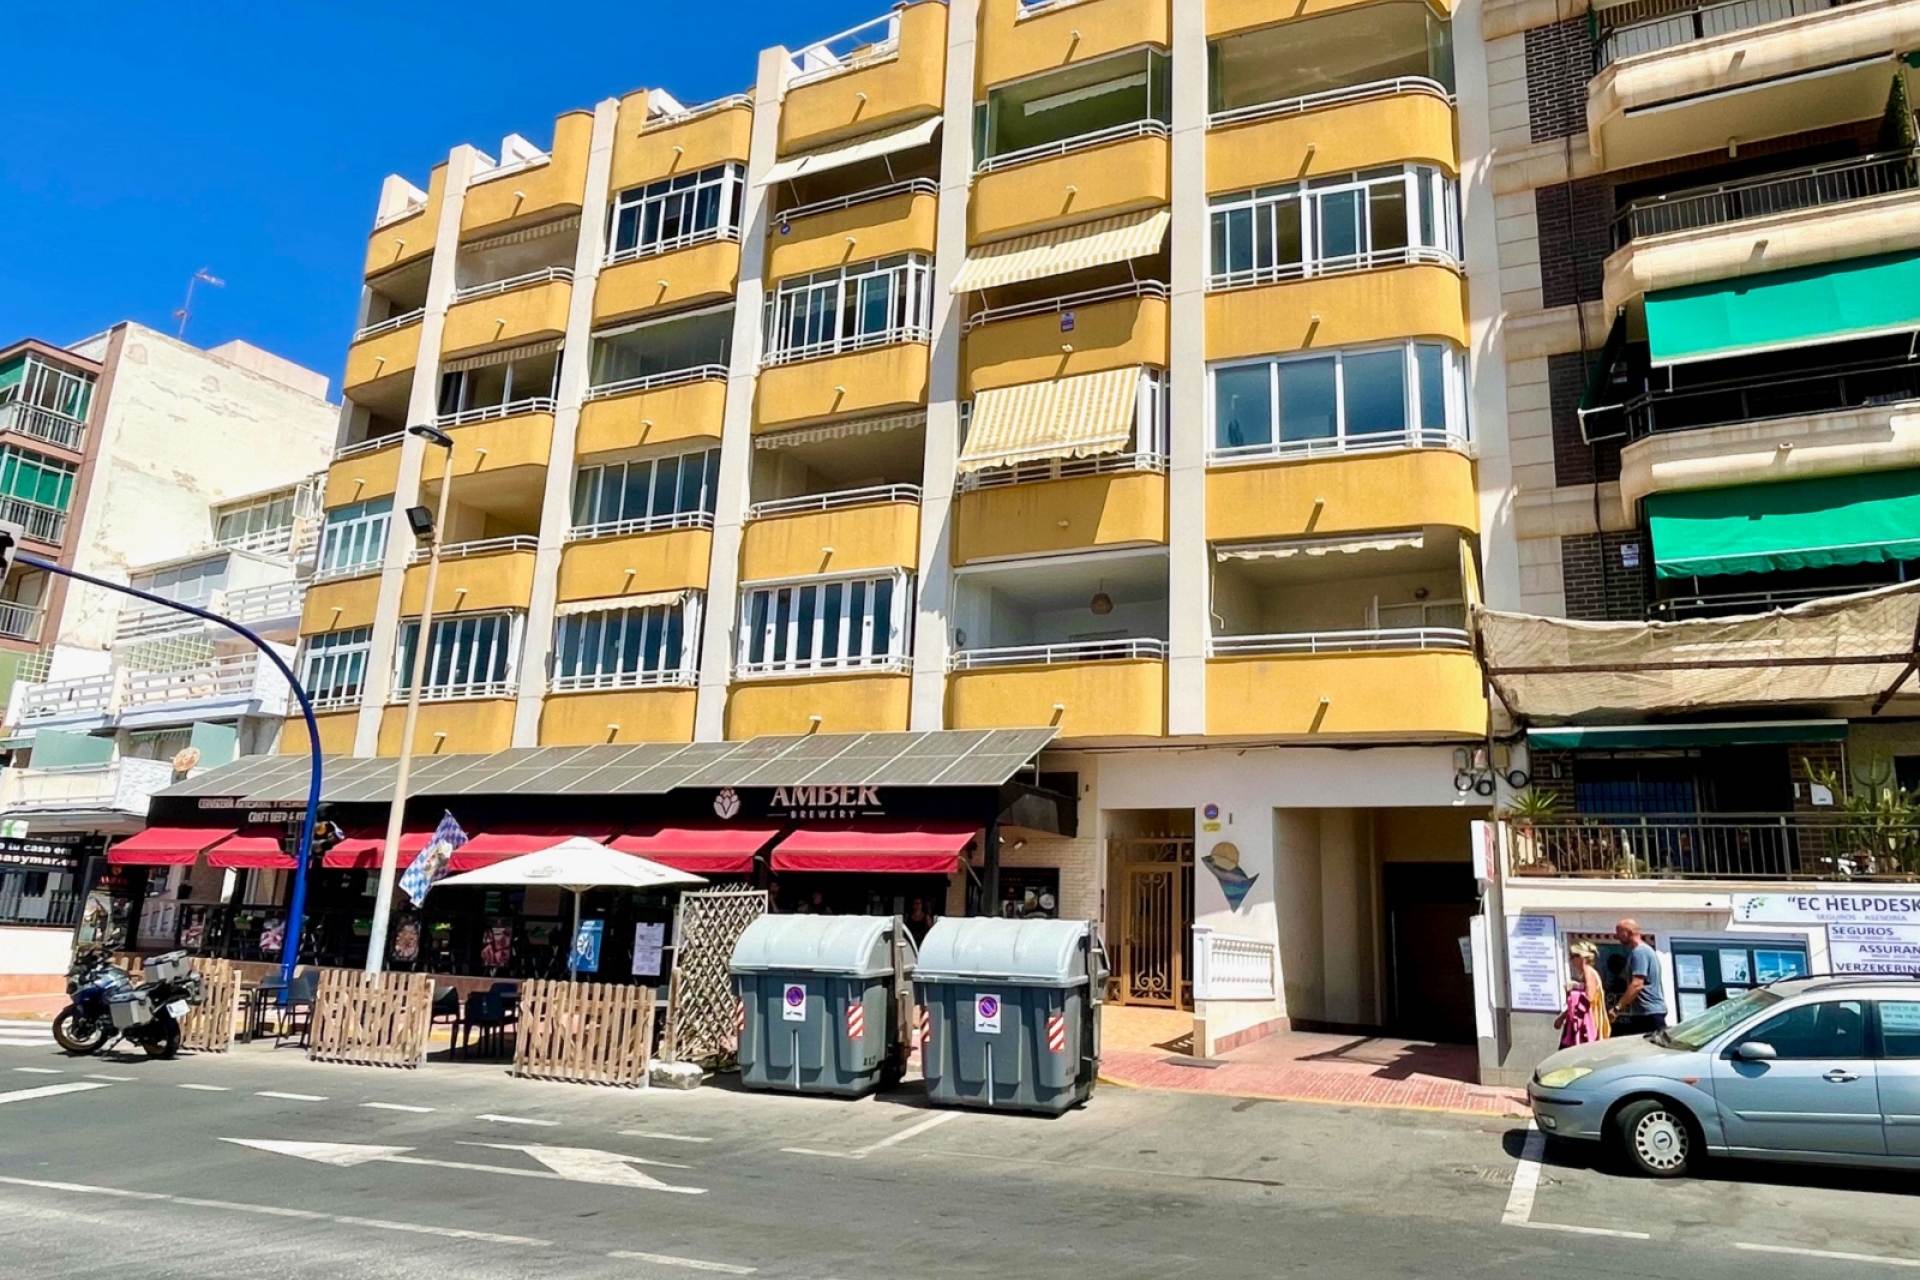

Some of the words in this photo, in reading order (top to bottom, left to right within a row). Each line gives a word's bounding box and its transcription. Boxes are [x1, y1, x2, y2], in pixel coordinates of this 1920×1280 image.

[770, 785, 882, 807] AMBER
[790, 809, 856, 819] BREWERY
[23, 844, 52, 854] casa
[1825, 897, 1920, 912] HELPDESK
[1831, 926, 1894, 936] SEGUROS
[1836, 962, 1920, 974] VERZEKERIN
